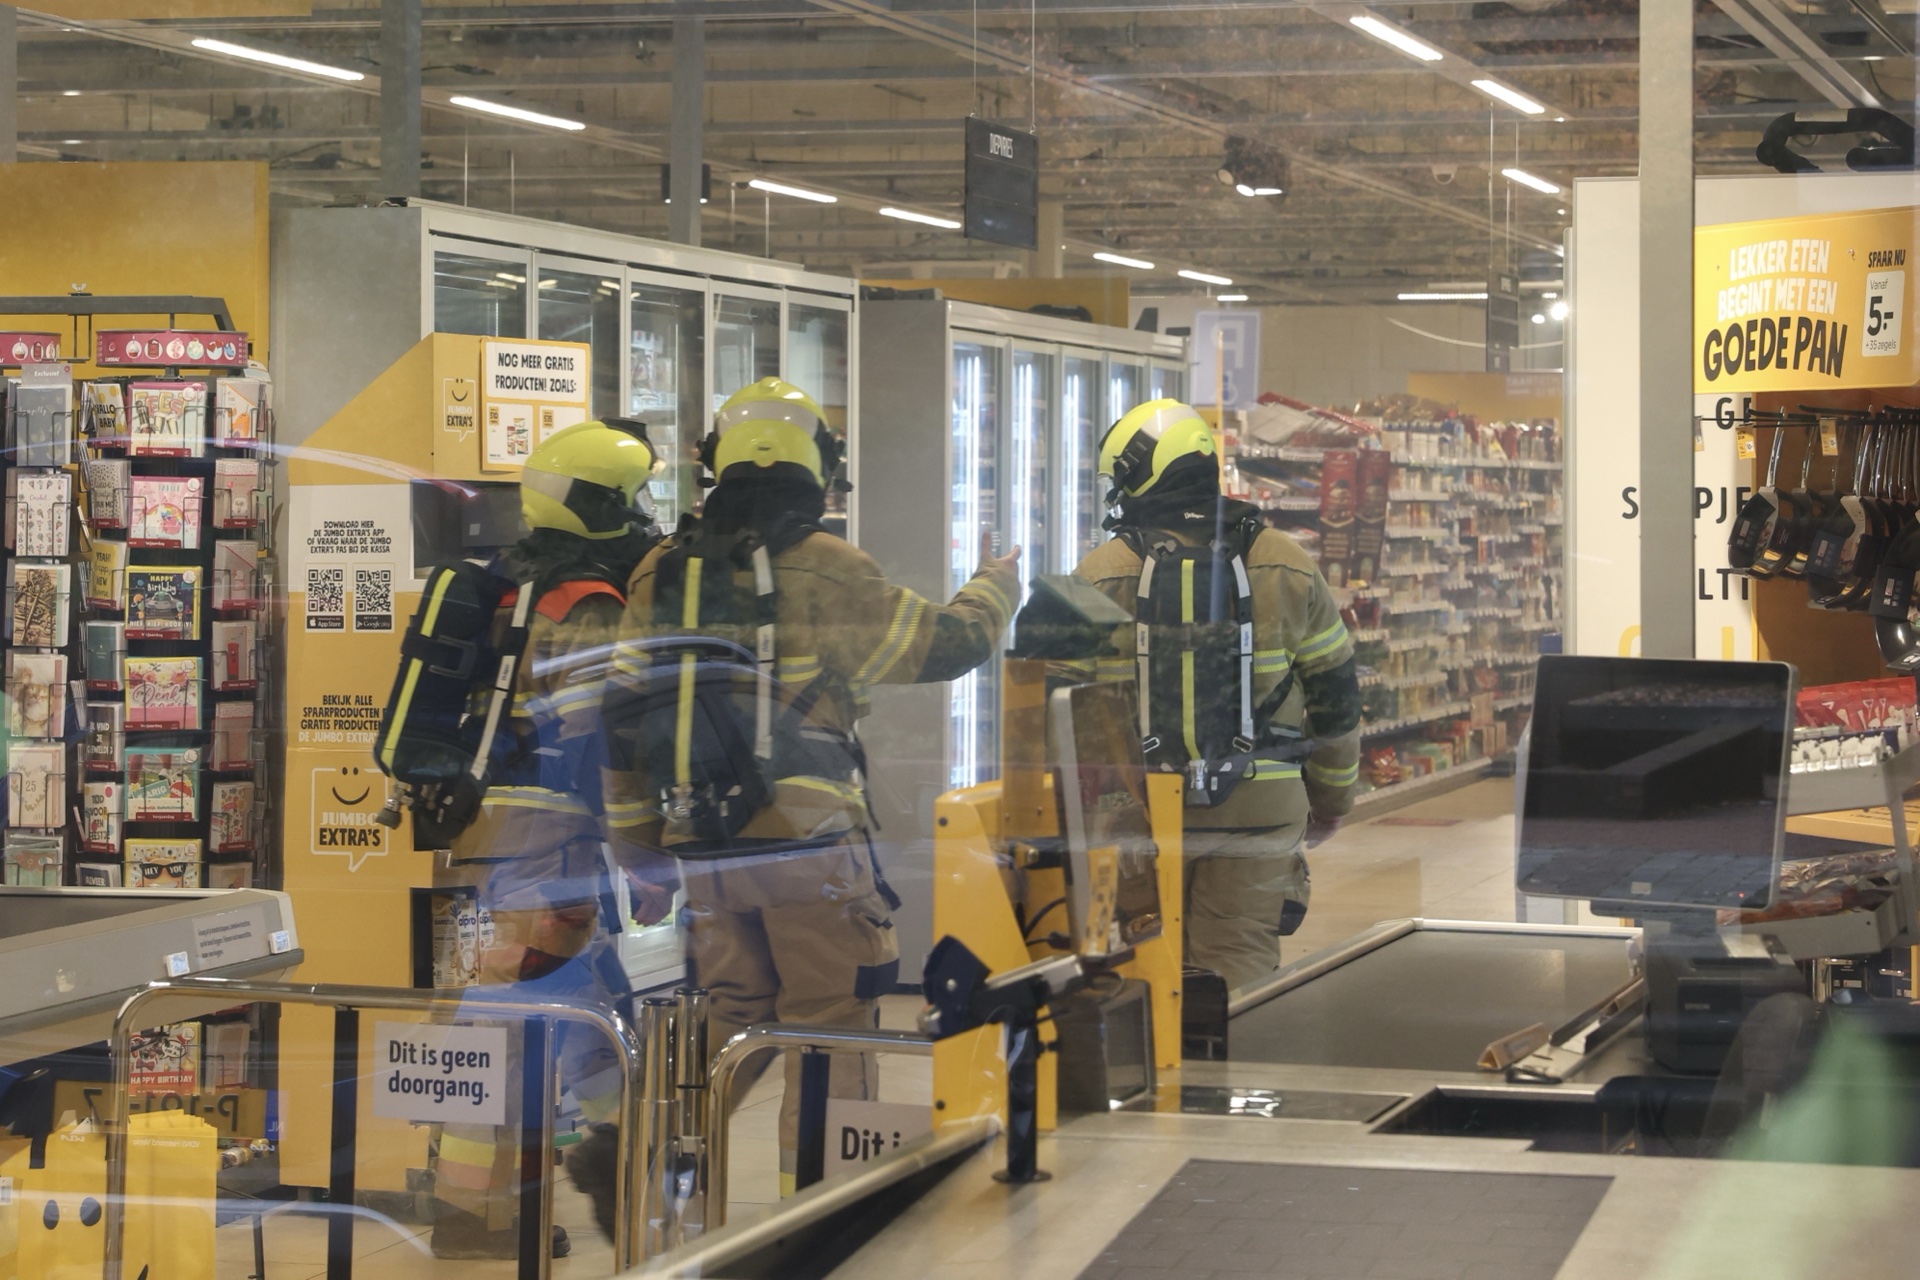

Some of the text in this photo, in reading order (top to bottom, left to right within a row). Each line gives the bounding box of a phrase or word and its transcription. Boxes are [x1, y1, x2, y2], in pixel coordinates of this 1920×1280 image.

[1729, 238, 1830, 281] LEKKER ETEN
[1868, 249, 1906, 268] SPAAR NU
[1870, 278, 1888, 290] Vanaf
[1718, 278, 1838, 323] BEGINT MET EEN
[1703, 316, 1848, 382] GOEDE PAN
[1878, 340, 1897, 351] zegels
[498, 352, 574, 371] NOG MEER GRATIS
[495, 375, 577, 393] PRODUCTEN! ZOALS:
[447, 405, 473, 415] JUMBO
[99, 417, 116, 428] BABY
[447, 415, 473, 427] EXTRA'S
[324, 520, 374, 529] DOWNLOAD HIER
[323, 529, 345, 537] JUMBO
[310, 546, 334, 554] EXTRA'S
[370, 545, 390, 553] KASSA
[147, 582, 177, 595] Birthday
[133, 681, 180, 705] Denk
[323, 695, 372, 705] BEKIJK ALLE
[303, 707, 379, 718] SPAARPRODUCTEN
[301, 719, 330, 730] GRATIS
[298, 731, 379, 743] DE JUMBO EXTRA'
[25, 780, 36, 792] 25
[320, 812, 378, 826] JUMBO
[319, 828, 381, 846] EXTRA'S
[144, 866, 159, 876] HEY
[389, 1040, 490, 1074] Dit is geen
[130, 1075, 193, 1085] HAPPY BIRTHDAY
[388, 1070, 490, 1105] doorgang.
[841, 1126, 885, 1162] Dit
